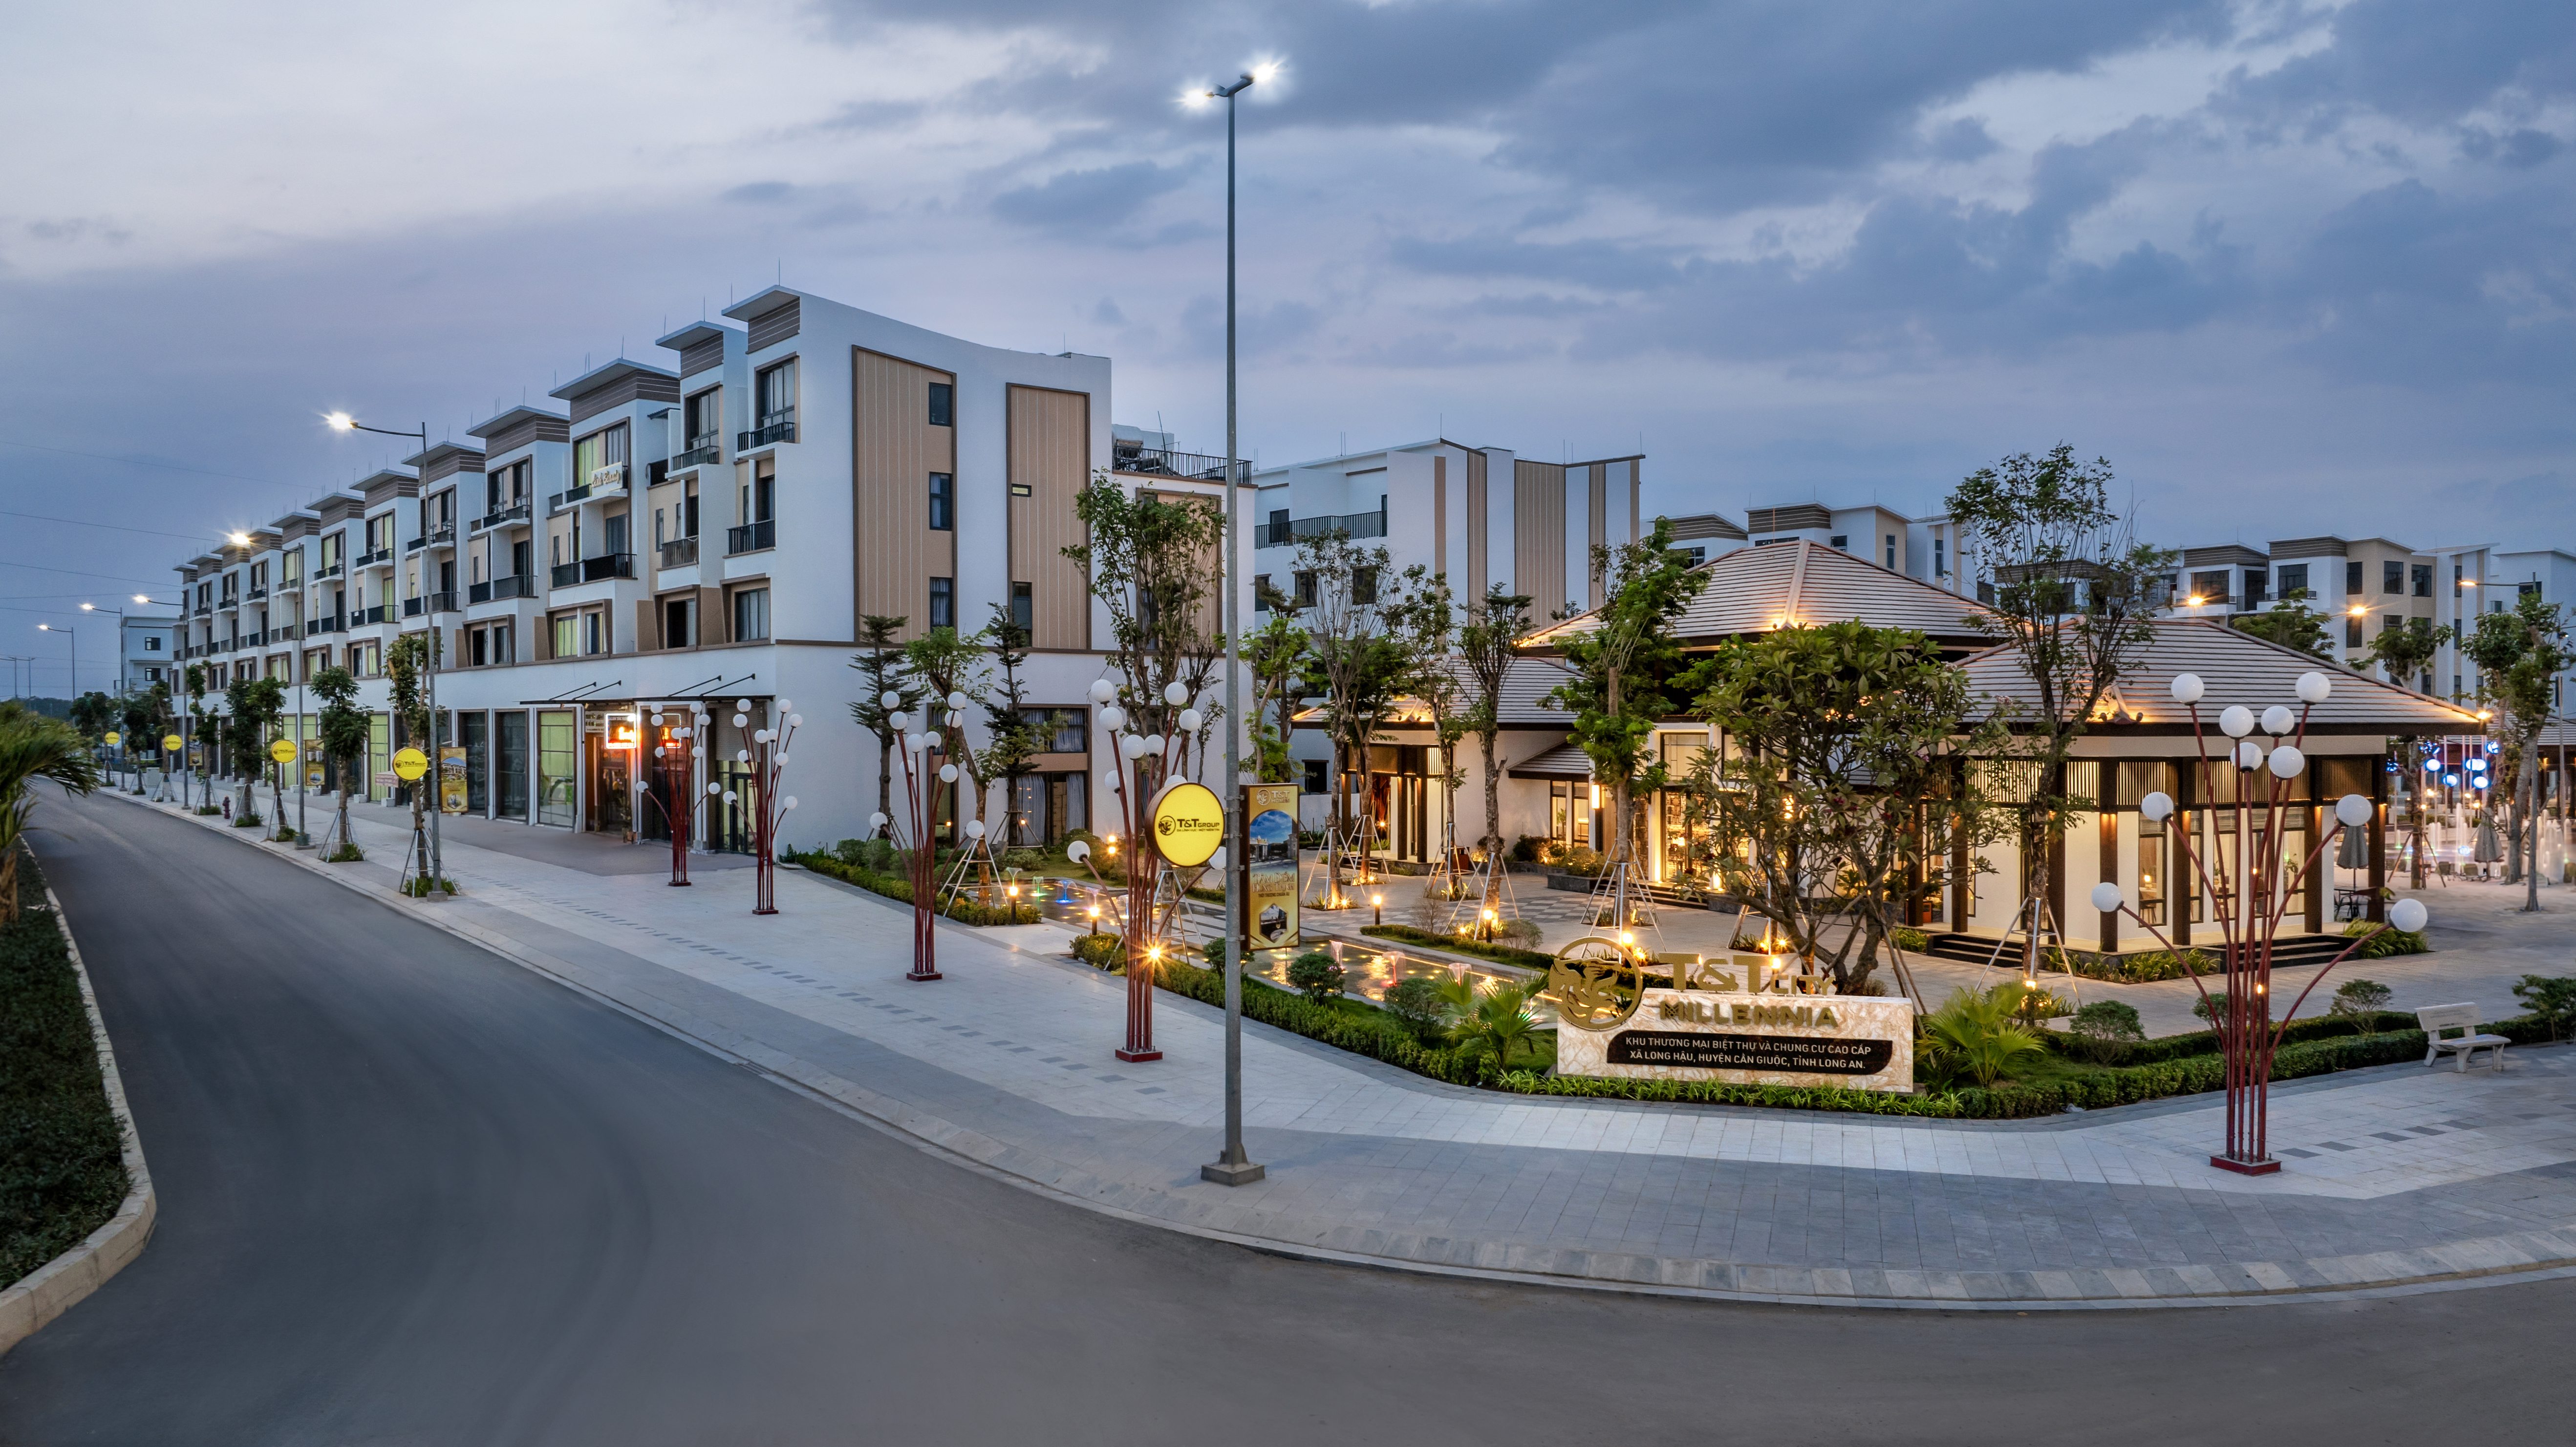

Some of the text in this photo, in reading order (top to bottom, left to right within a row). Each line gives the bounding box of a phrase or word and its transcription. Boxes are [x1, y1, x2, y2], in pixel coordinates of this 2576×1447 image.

[1271, 790, 1290, 799] T&T
[1177, 818, 1200, 828] T&T
[1659, 953, 1836, 997] T&T CITY
[1659, 1001, 1838, 1027] MILLENNIA
[1626, 1037, 1646, 1046] KHU
[1648, 1037, 1690, 1048] THƯƠNG
[1692, 1040, 1710, 1050] MẠI
[1712, 1039, 1734, 1051] BIỆT
[1736, 1041, 1757, 1052] THỰ
[1759, 1041, 1772, 1051] VÀ
[1773, 1043, 1809, 1052] CHUNG
[1811, 1044, 1826, 1053] CƯ
[1828, 1045, 1849, 1054] CAO
[1630, 1049, 1866, 1069] XÃ LONG HẬU, HUYỆN CẦN GIUỘC, TỈNH LONG AN.
